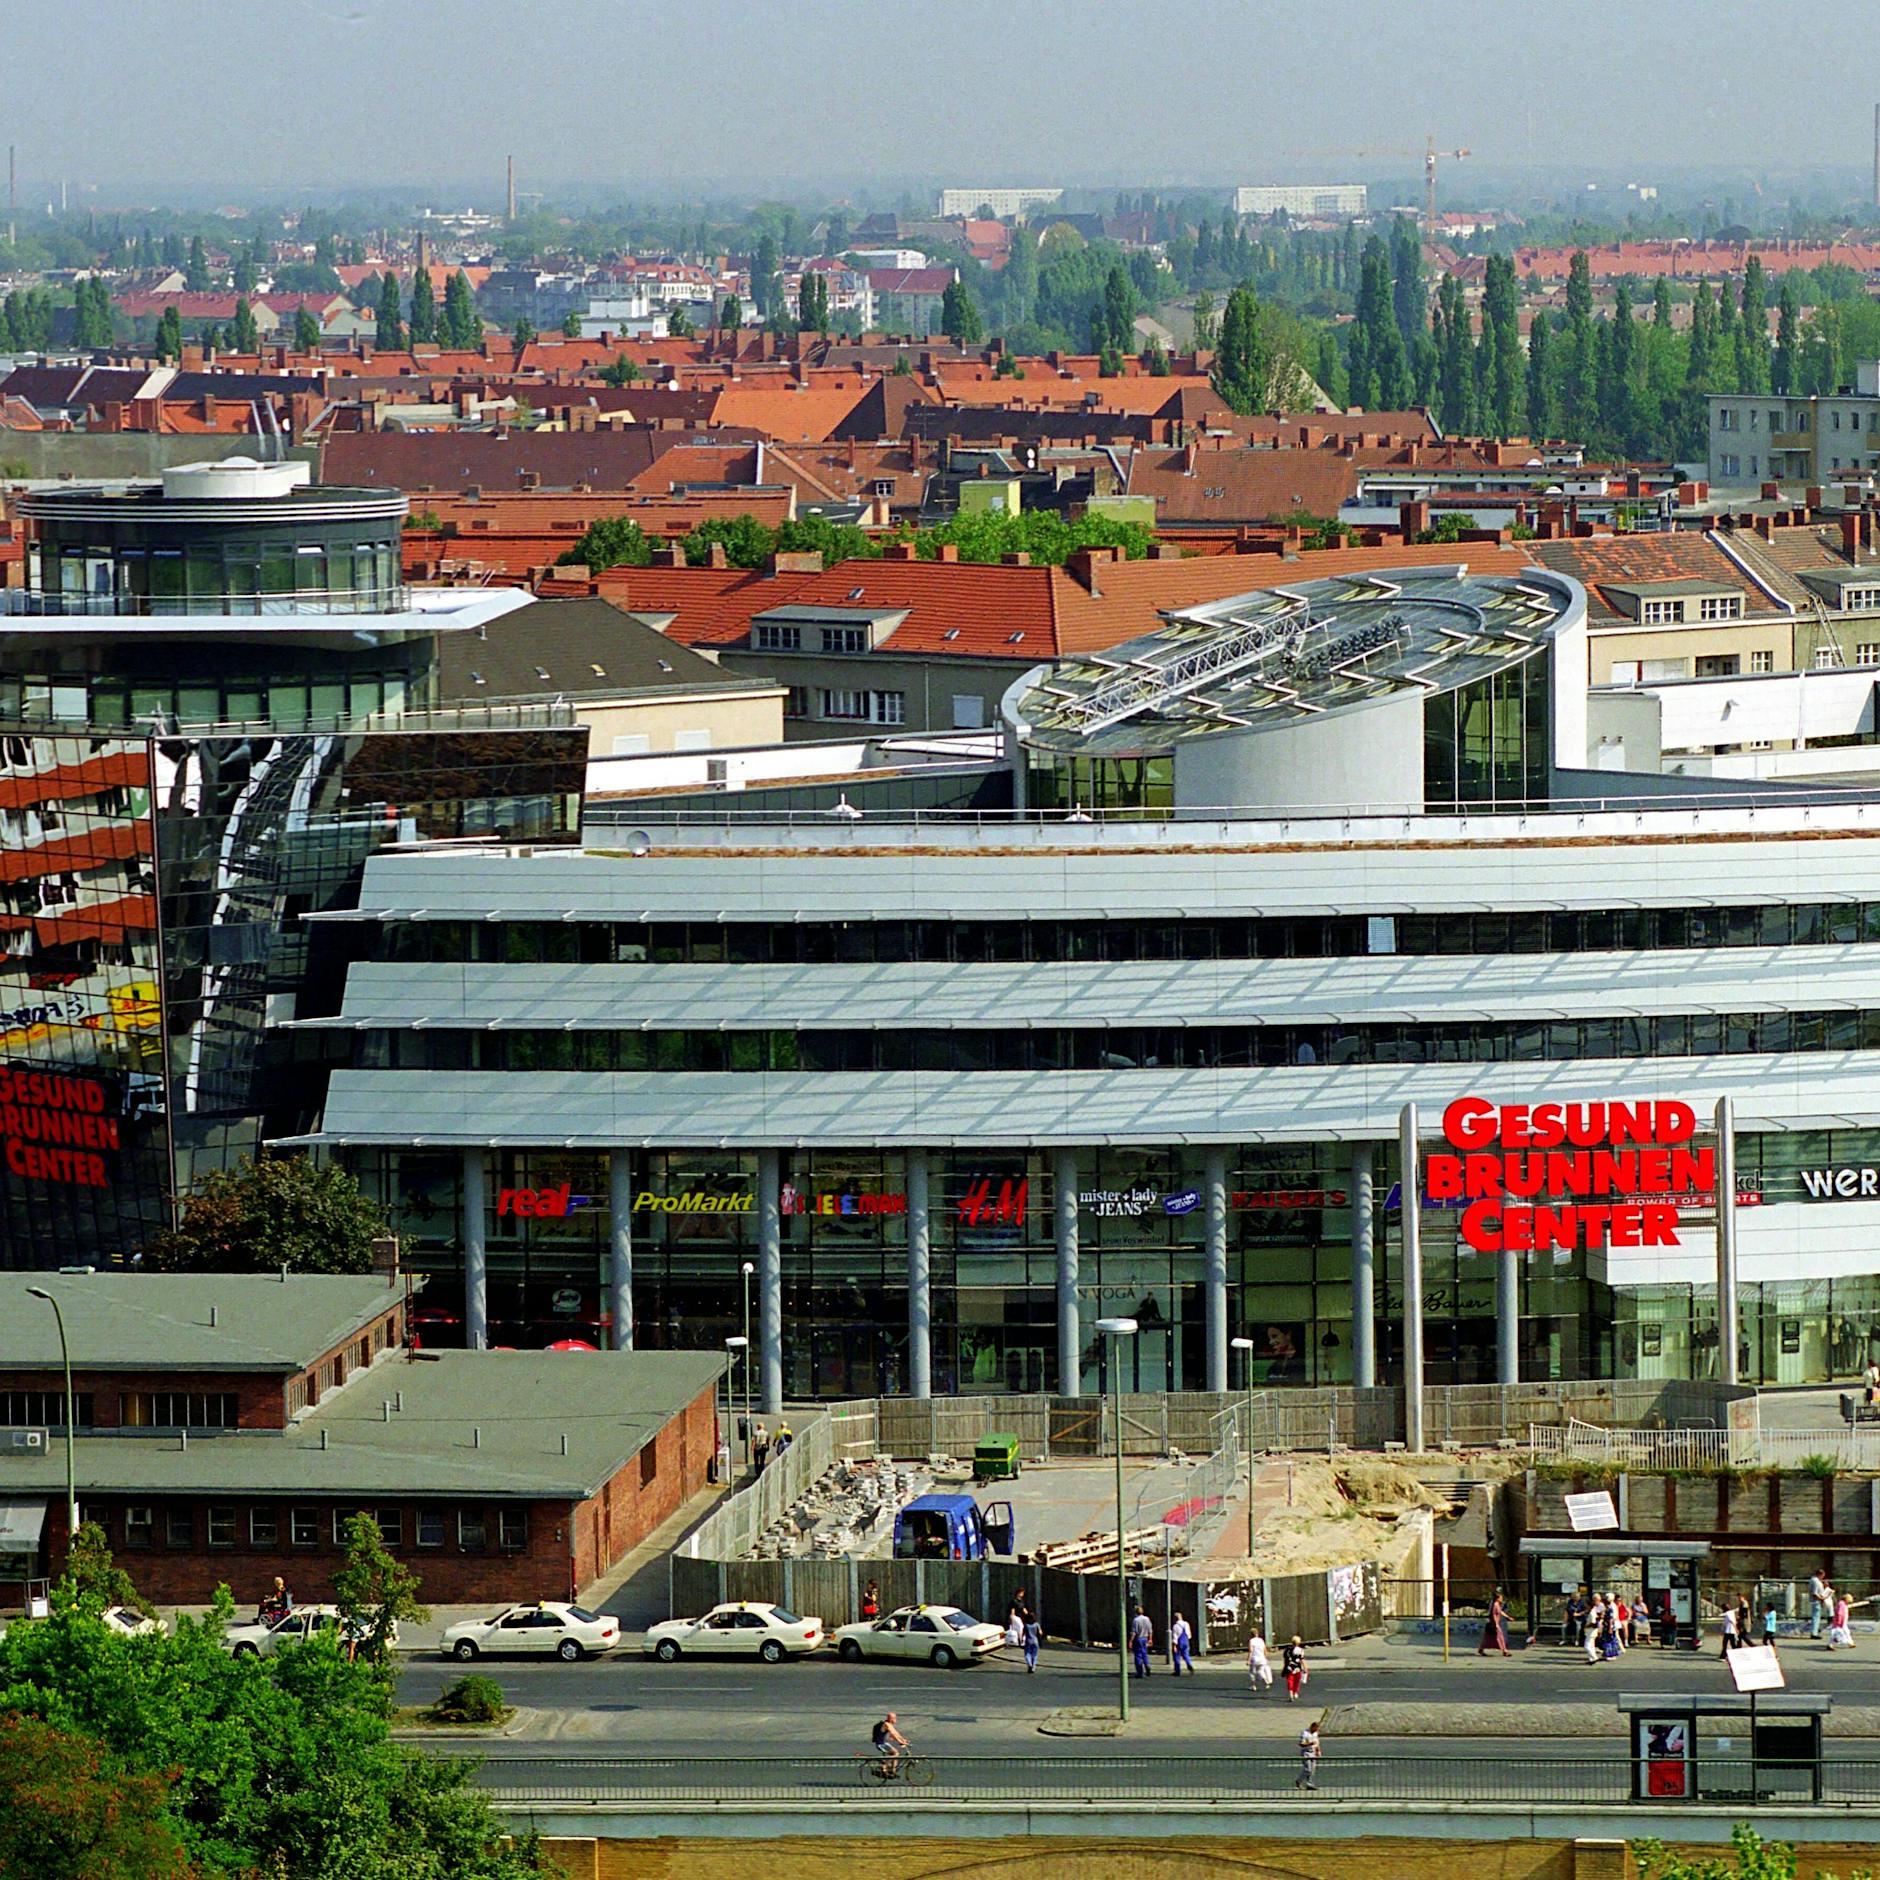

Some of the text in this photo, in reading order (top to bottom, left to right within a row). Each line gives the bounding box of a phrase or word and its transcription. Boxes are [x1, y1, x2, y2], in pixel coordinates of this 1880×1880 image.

[0, 1064, 105, 1113] GESUND
[0, 1102, 120, 1150] RUNNEN
[1442, 1096, 1697, 1150] GESUND
[6, 1137, 108, 1188] CENTER
[1427, 1147, 1716, 1199] BRUNNEN
[633, 1192, 755, 1212] ProMarkt
[957, 1179, 1029, 1227] H&M
[1080, 1189, 1121, 1203] mister
[1132, 1188, 1158, 1205] lady
[1096, 1202, 1142, 1217] JEANS
[1461, 1200, 1682, 1252] CENTER
